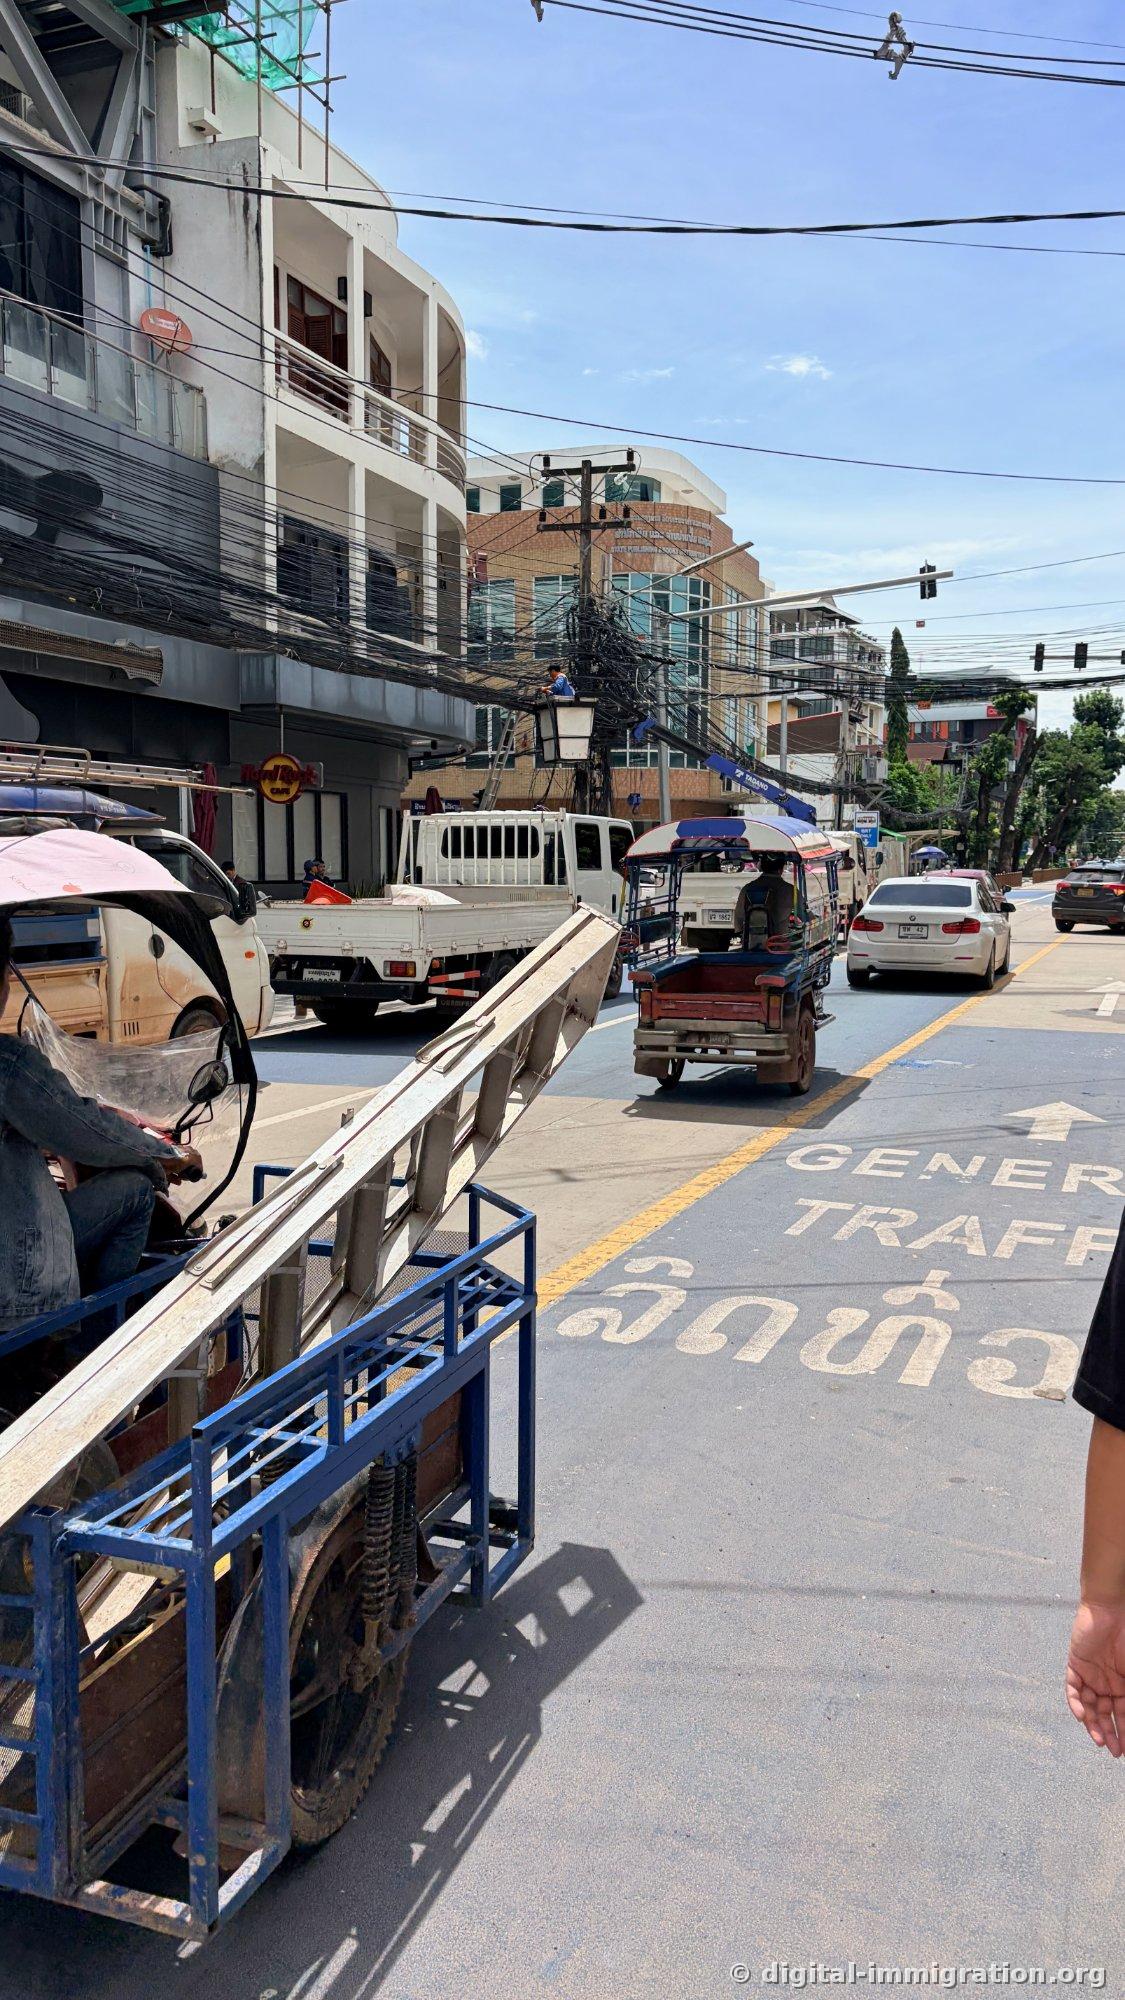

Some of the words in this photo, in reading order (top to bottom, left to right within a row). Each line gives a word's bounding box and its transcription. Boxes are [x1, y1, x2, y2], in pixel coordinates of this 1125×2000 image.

[745, 773, 769, 790] TADANO
[786, 1143, 1125, 1196] GENER
[784, 1198, 1120, 1266] TRAFF
